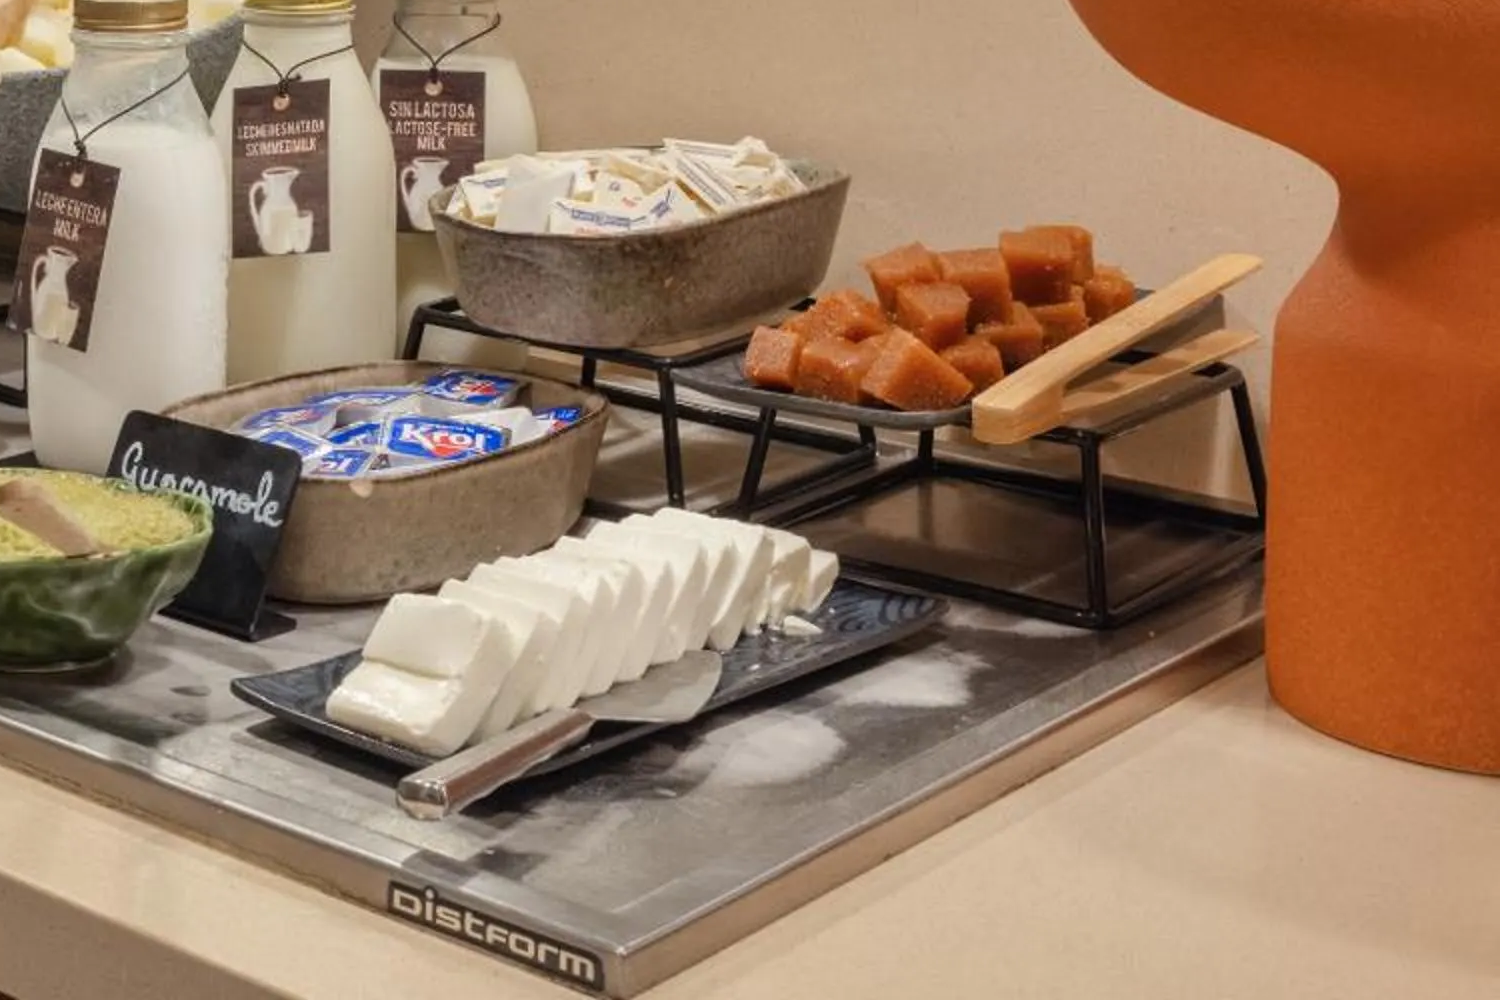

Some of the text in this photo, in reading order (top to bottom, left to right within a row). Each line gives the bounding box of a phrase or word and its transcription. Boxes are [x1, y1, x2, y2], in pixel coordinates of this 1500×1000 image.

[388, 101, 476, 119] SIN LACTOSA
[417, 136, 446, 151] MILK
[121, 441, 283, 528] Guacamole
[392, 888, 596, 983] Distform
